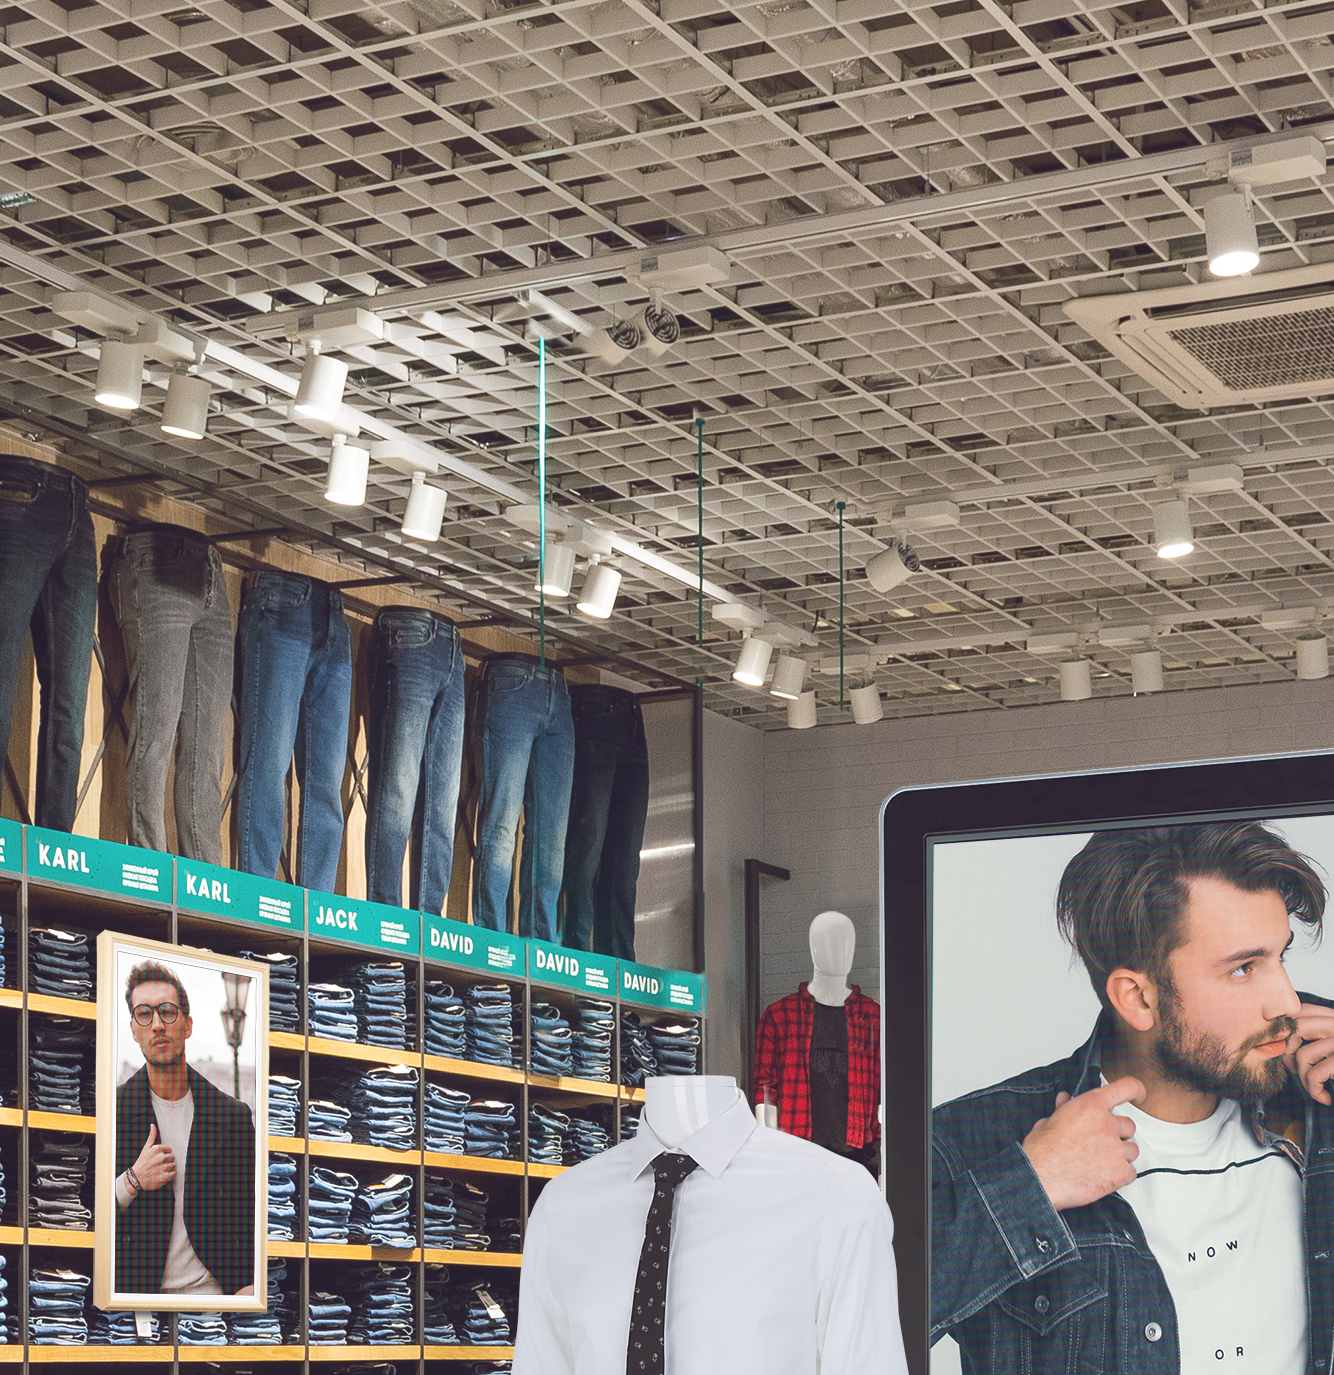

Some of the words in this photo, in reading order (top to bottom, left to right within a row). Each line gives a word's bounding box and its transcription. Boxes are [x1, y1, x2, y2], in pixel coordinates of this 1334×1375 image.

[38, 844, 90, 873] KARL
[186, 874, 231, 903] KARL
[315, 906, 358, 931] JACK
[430, 927, 474, 955] DAVID
[536, 949, 579, 977] DAVID
[624, 972, 659, 995] DAVID
[1188, 1240, 1239, 1262] NOW
[1215, 1346, 1244, 1360] OR
